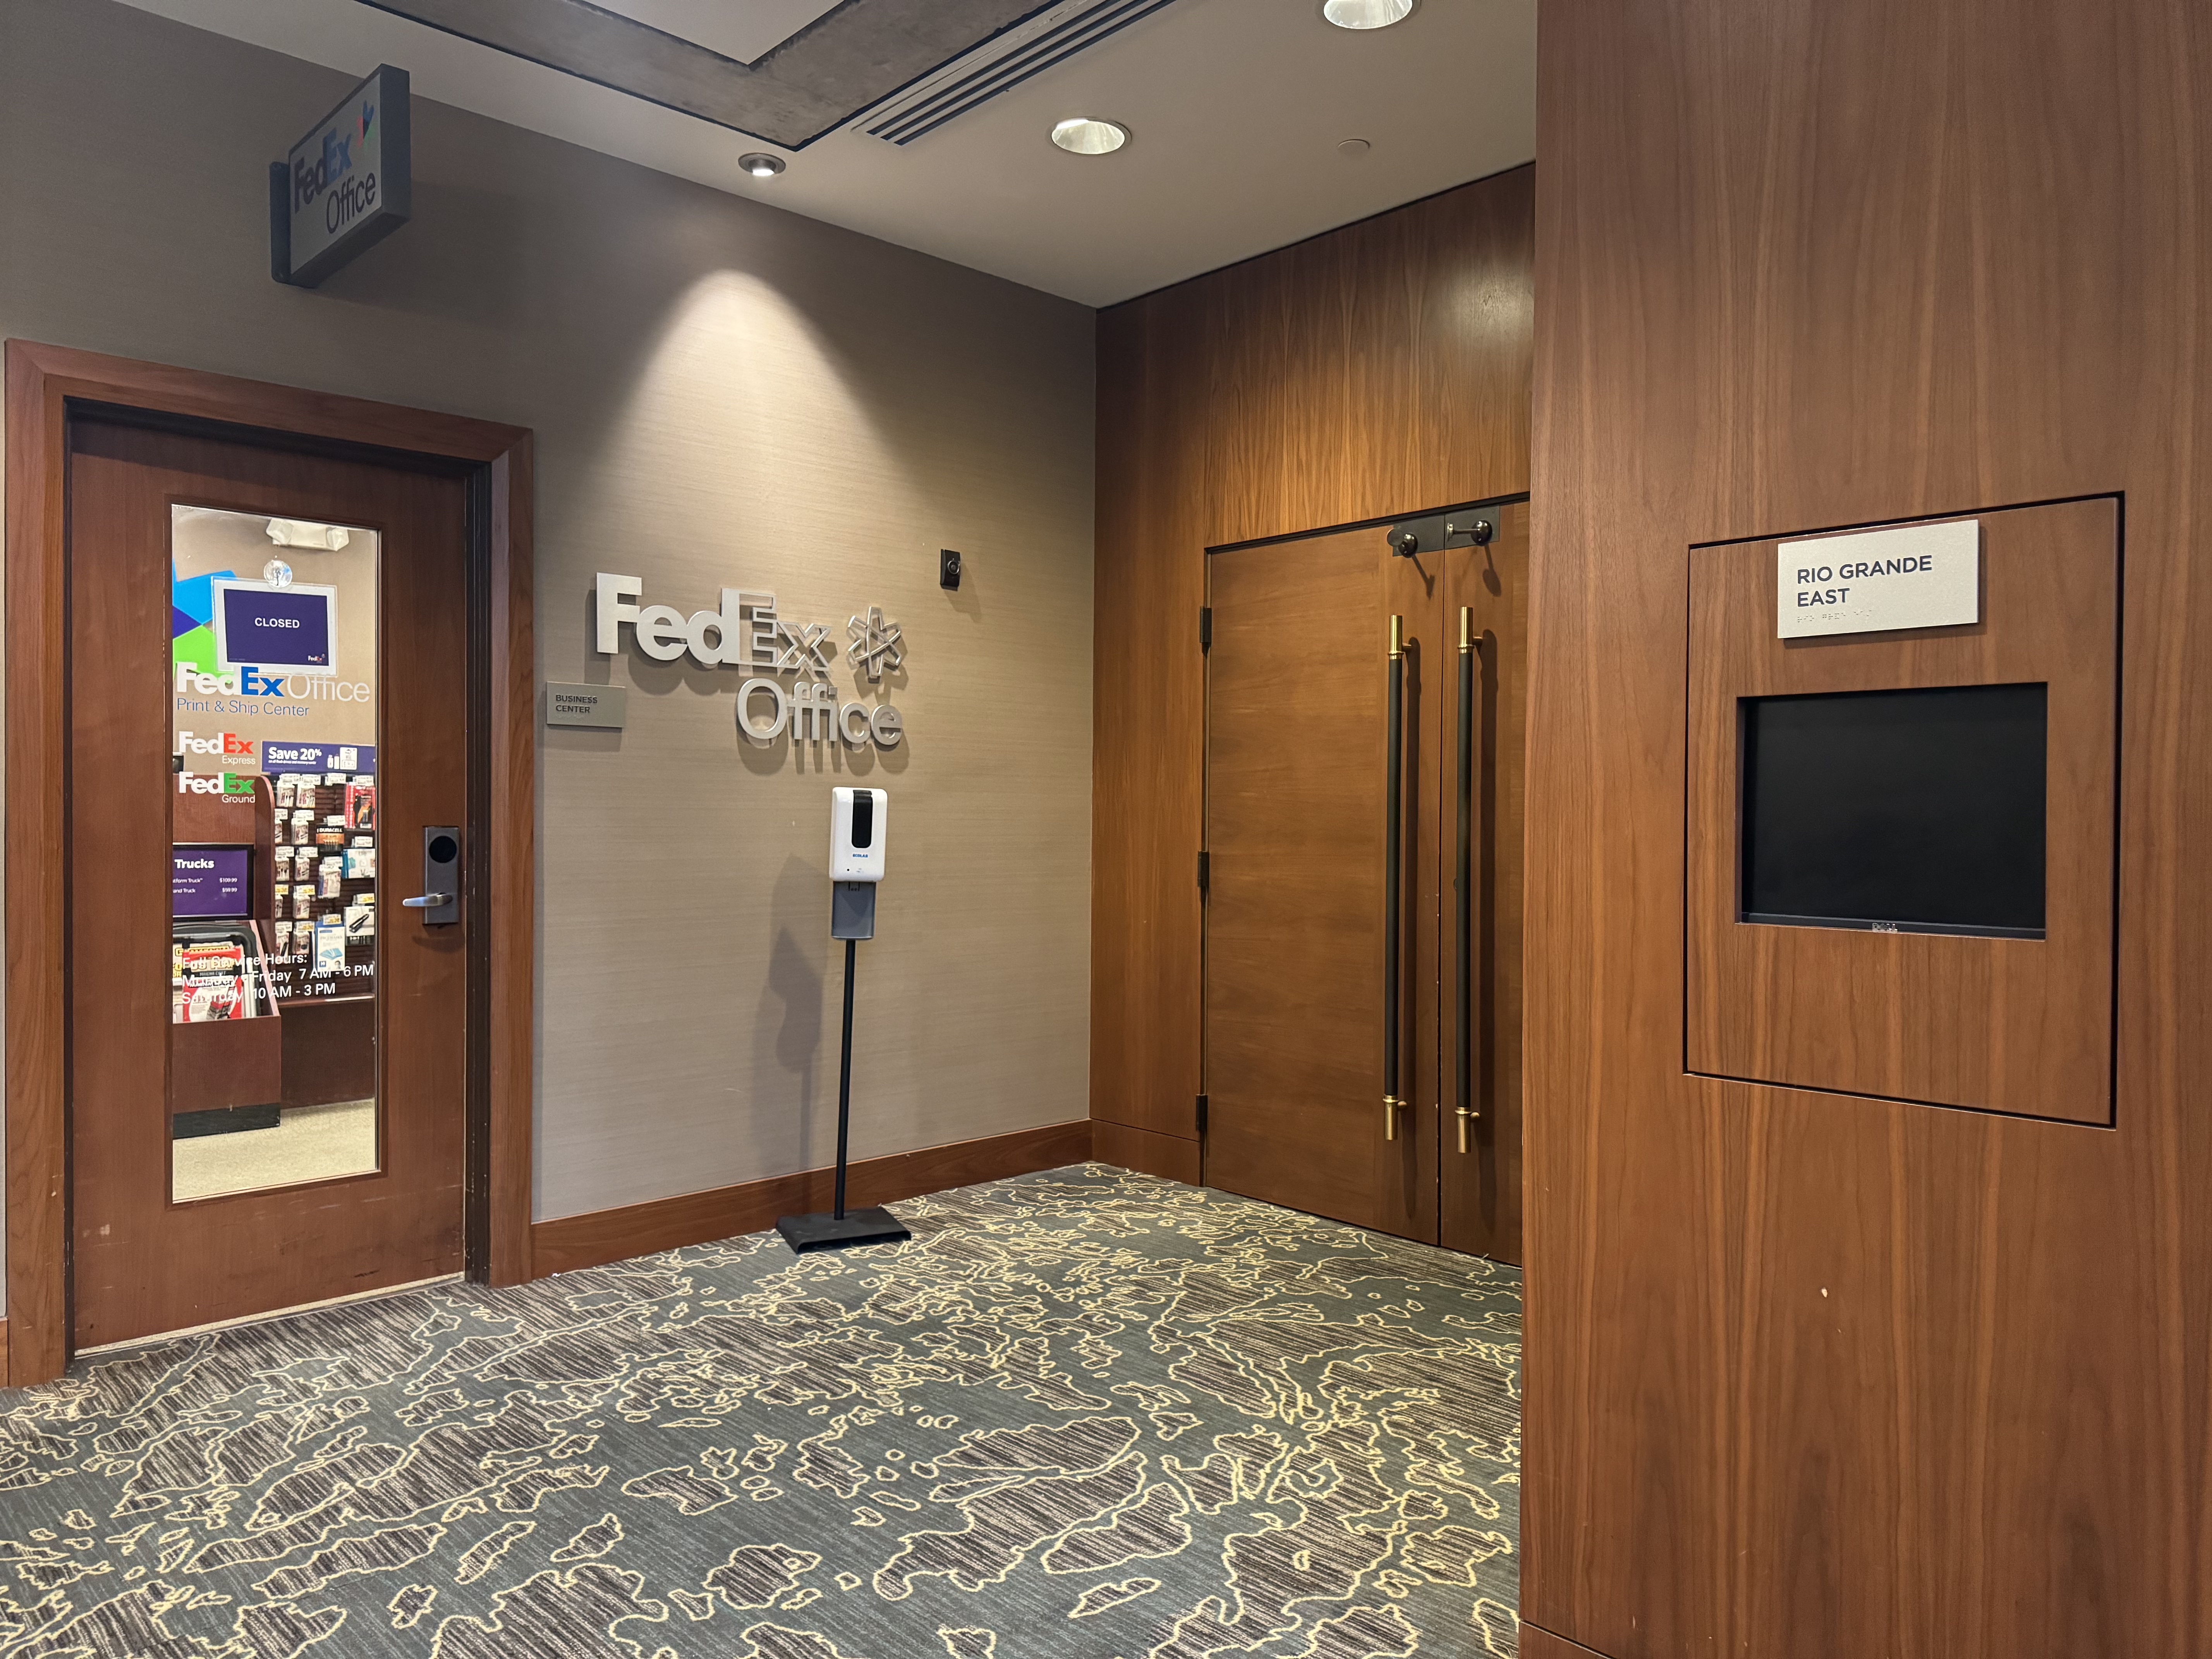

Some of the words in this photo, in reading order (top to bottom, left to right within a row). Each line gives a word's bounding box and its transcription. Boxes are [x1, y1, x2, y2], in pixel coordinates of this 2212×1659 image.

[293, 127, 352, 214] FedEx
[327, 173, 376, 234] Office
[1798, 566, 1833, 584] RIO
[1839, 555, 1932, 579] GRANDE
[1798, 588, 1850, 607] EAST
[254, 617, 300, 629] CLOSED
[597, 572, 831, 672] FedEx
[177, 698, 210, 712] Print
[215, 701, 224, 712] &
[229, 701, 258, 716] Ship
[264, 702, 310, 716] Center
[556, 694, 598, 703] BUSINESS
[556, 705, 590, 713] CENTER
[737, 678, 903, 746] Office
[179, 731, 253, 754] FedEx
[222, 755, 256, 765] Express
[268, 747, 298, 759] Save
[300, 748, 322, 761] 20%
[179, 771, 255, 794] FedEx
[222, 794, 255, 804] Ground
[174, 859, 215, 869] Trucks
[266, 953, 307, 965] Hours:
[252, 969, 292, 983] Friday
[299, 968, 307, 979] 7
[309, 967, 331, 979] AM
[343, 966, 351, 977] 6
[354, 964, 374, 976] PM
[252, 988, 266, 999] 10
[270, 986, 292, 998] AM
[304, 984, 311, 996] 3
[316, 982, 335, 995] PM
